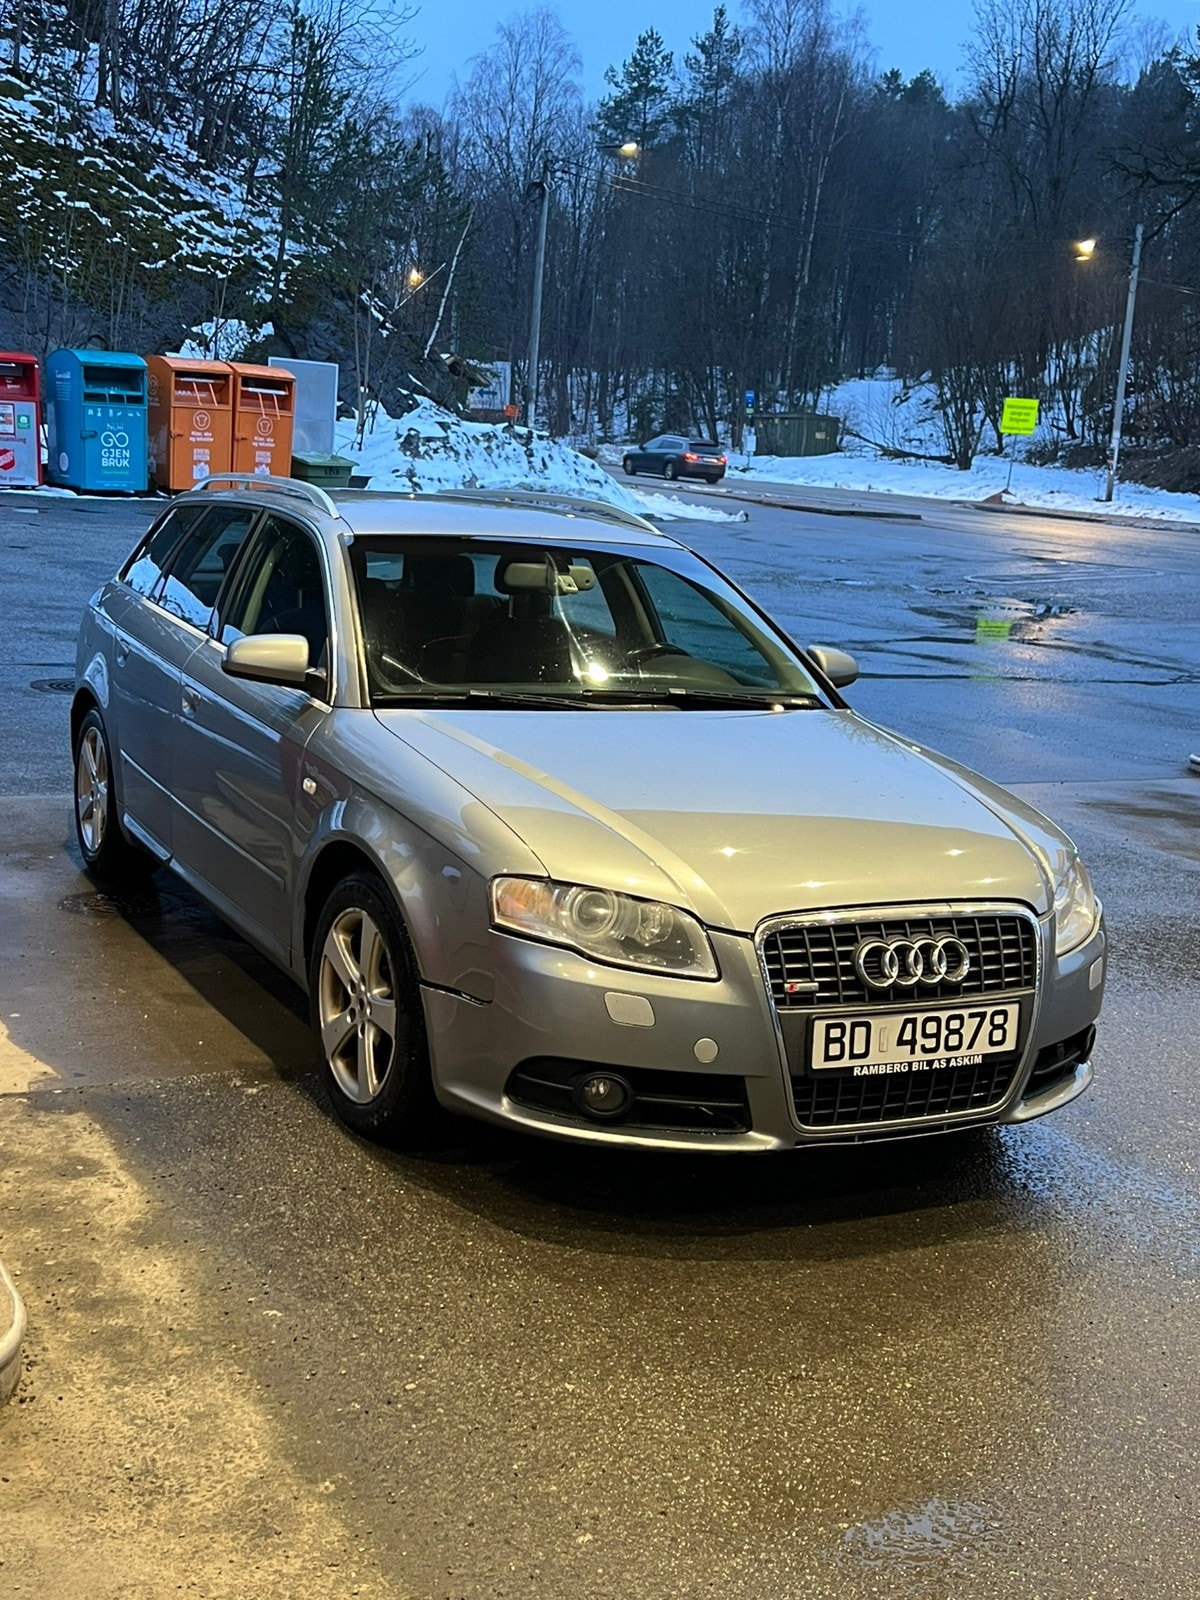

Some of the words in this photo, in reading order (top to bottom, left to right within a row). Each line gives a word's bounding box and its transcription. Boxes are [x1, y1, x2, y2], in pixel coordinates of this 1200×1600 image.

[101, 448, 130, 458] GJEN
[101, 457, 130, 467] BRUK
[823, 1020, 872, 1062] BD
[896, 1008, 1009, 1055] 49878
[853, 1062, 909, 1077] RAMBERG
[911, 1060, 930, 1072] BIL
[932, 1059, 947, 1069] AS
[949, 1054, 983, 1067] ASKIM
